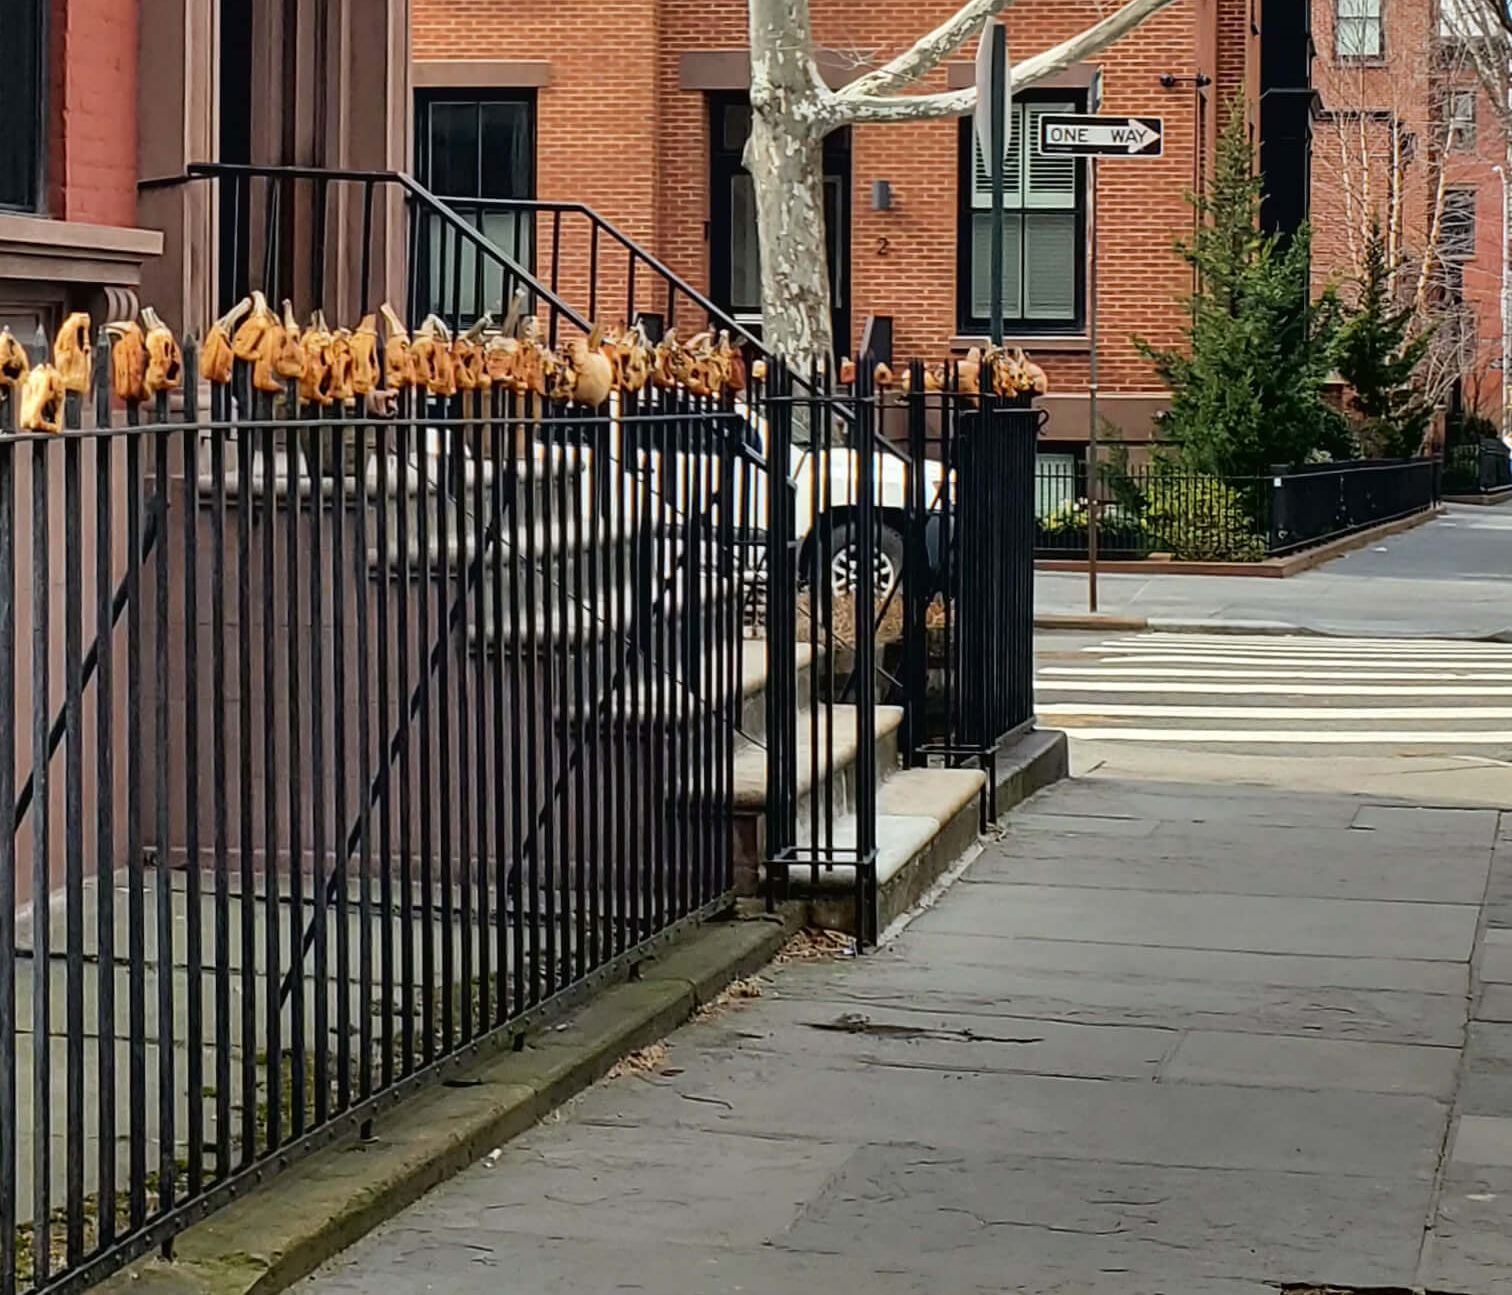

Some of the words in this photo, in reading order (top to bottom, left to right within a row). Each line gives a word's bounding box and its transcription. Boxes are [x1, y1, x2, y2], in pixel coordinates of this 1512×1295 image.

[1050, 127, 1088, 142] ONE
[1110, 129, 1148, 143] WAY
[877, 237, 889, 256] 2
